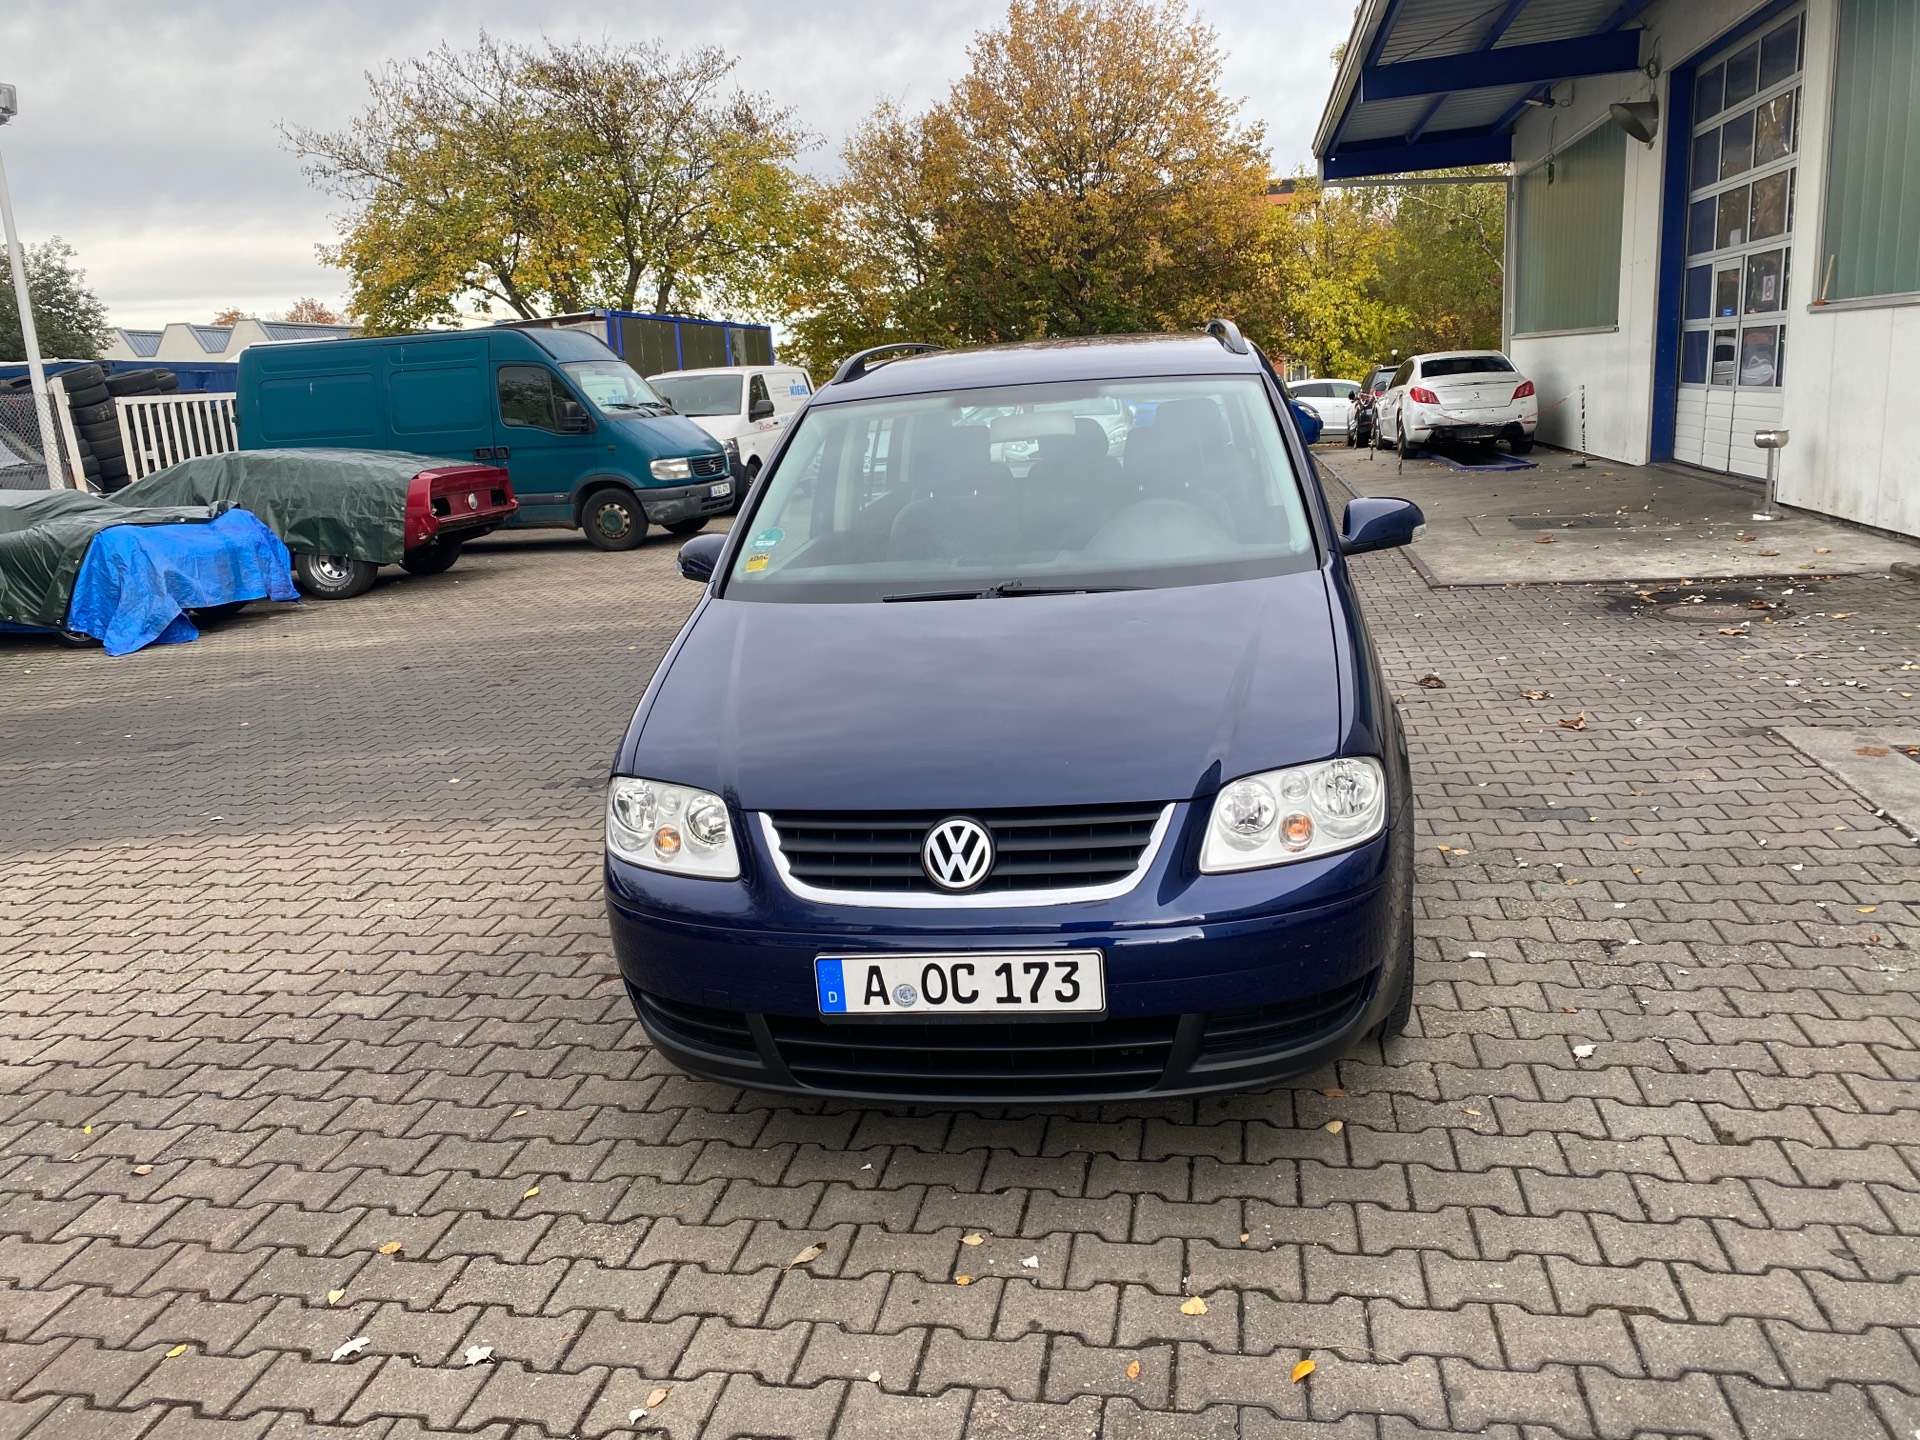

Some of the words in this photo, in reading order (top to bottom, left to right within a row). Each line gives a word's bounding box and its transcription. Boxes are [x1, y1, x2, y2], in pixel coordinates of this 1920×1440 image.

[924, 819, 991, 889] VW
[828, 991, 838, 1003] D
[864, 965, 890, 1006] A
[921, 962, 979, 1005] OC
[995, 961, 1080, 1004] 173
